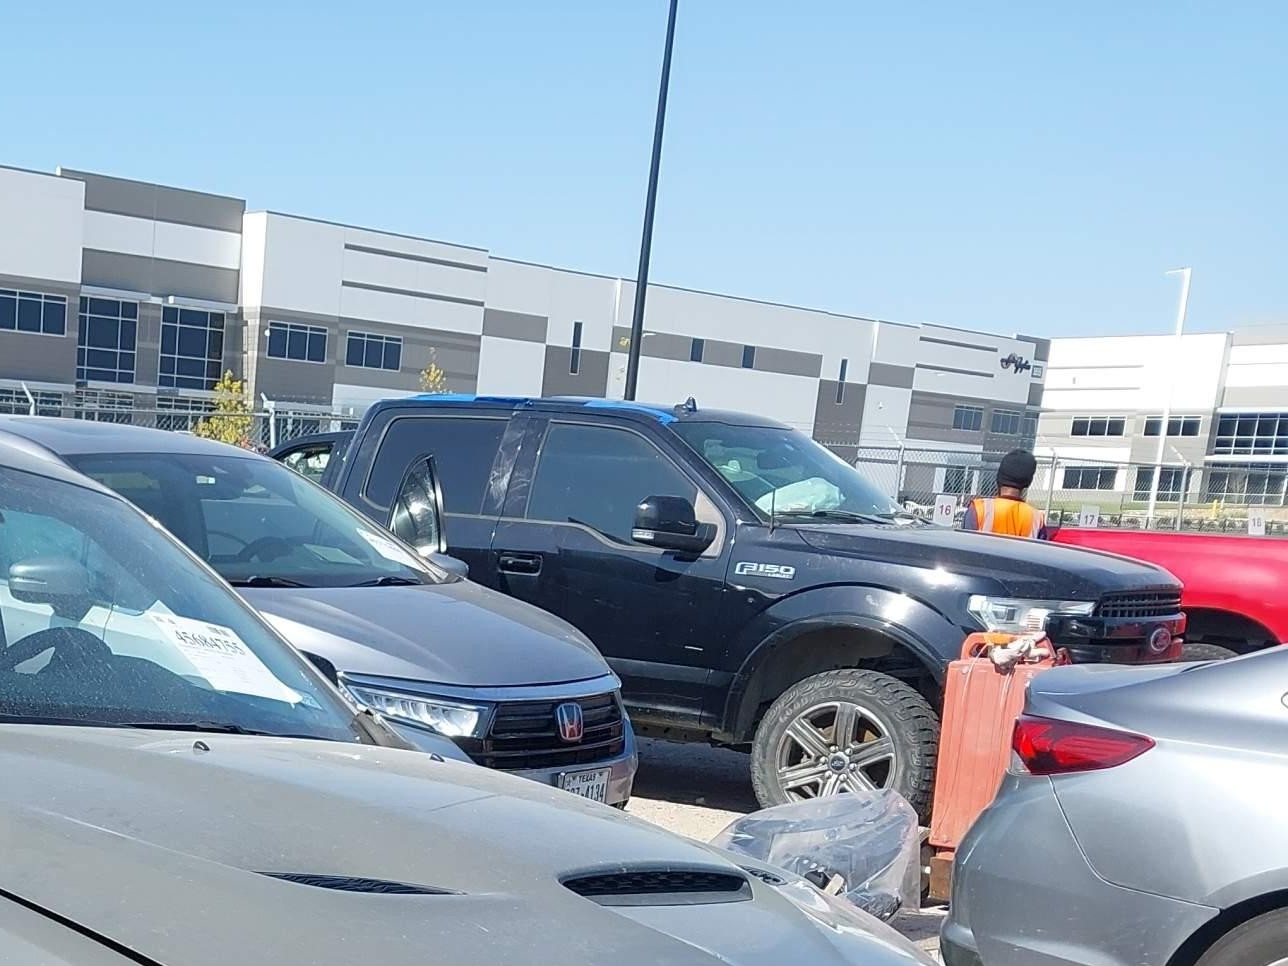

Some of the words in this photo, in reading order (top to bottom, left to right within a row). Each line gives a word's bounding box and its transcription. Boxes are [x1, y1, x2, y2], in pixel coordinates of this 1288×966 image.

[939, 504, 952, 516] 16
[1084, 514, 1095, 525] 17
[175, 630, 245, 656] 45684755
[579, 773, 597, 784] TEXAS
